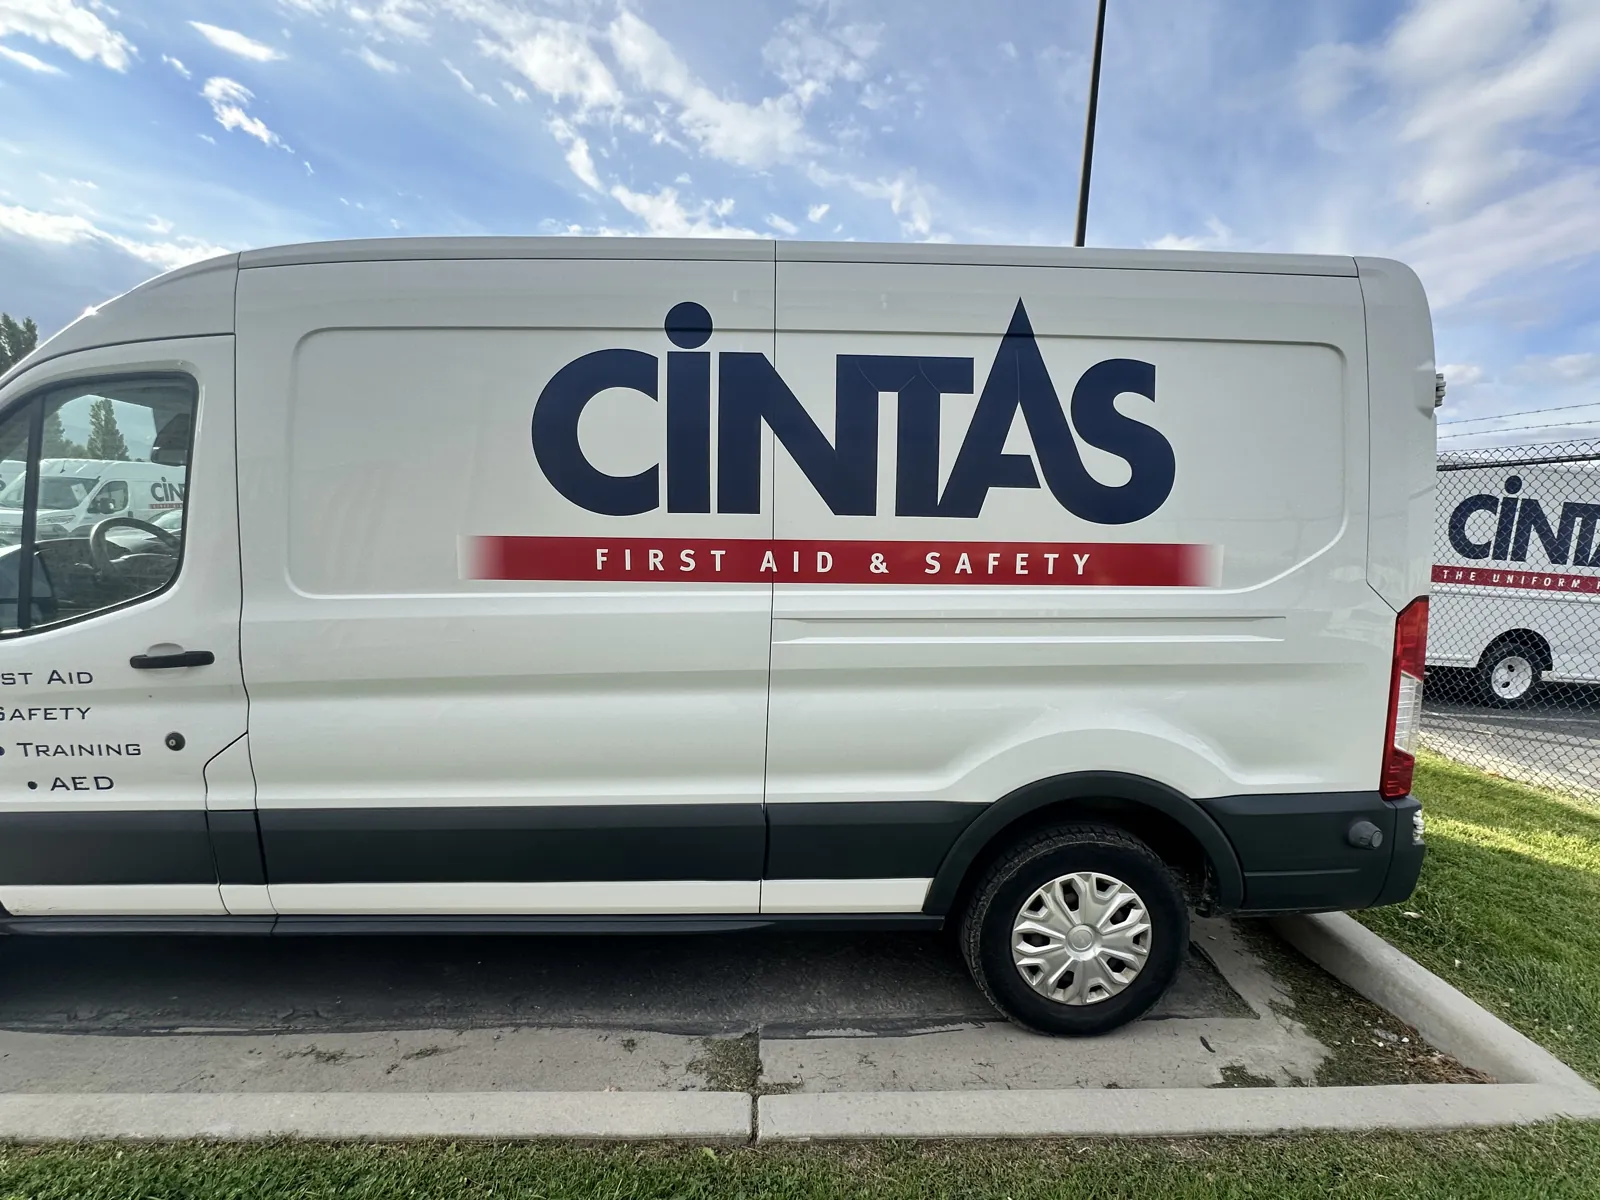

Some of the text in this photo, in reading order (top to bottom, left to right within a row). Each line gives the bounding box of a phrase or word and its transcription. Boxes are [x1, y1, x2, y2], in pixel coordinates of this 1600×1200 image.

[595, 548, 1091, 576] FIRST AID & SAFETY
[1442, 569, 1477, 582] THE
[1492, 574, 1581, 589] UNIFORM
[47, 669, 94, 685] AID
[16, 742, 142, 757] TRAINING
[50, 775, 115, 791] AED
